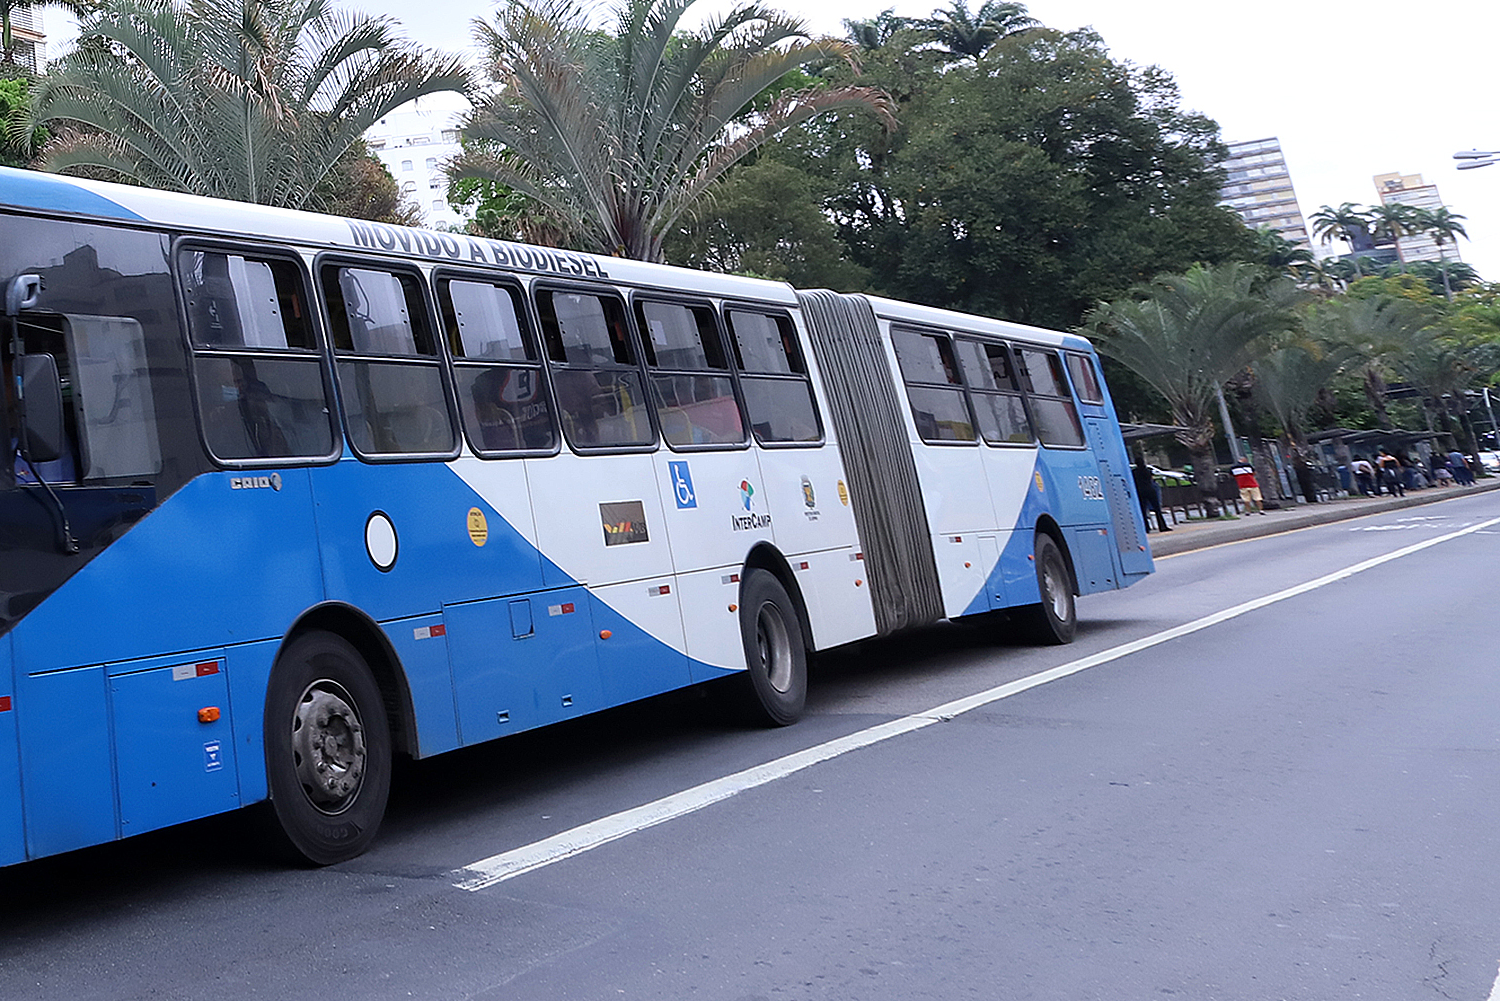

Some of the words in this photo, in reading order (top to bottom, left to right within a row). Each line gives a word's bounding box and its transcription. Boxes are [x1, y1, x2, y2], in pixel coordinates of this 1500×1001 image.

[348, 219, 460, 259] MOVIDO
[465, 238, 487, 264] A
[487, 241, 609, 278] BIODIESEL
[230, 476, 270, 490] CAIO
